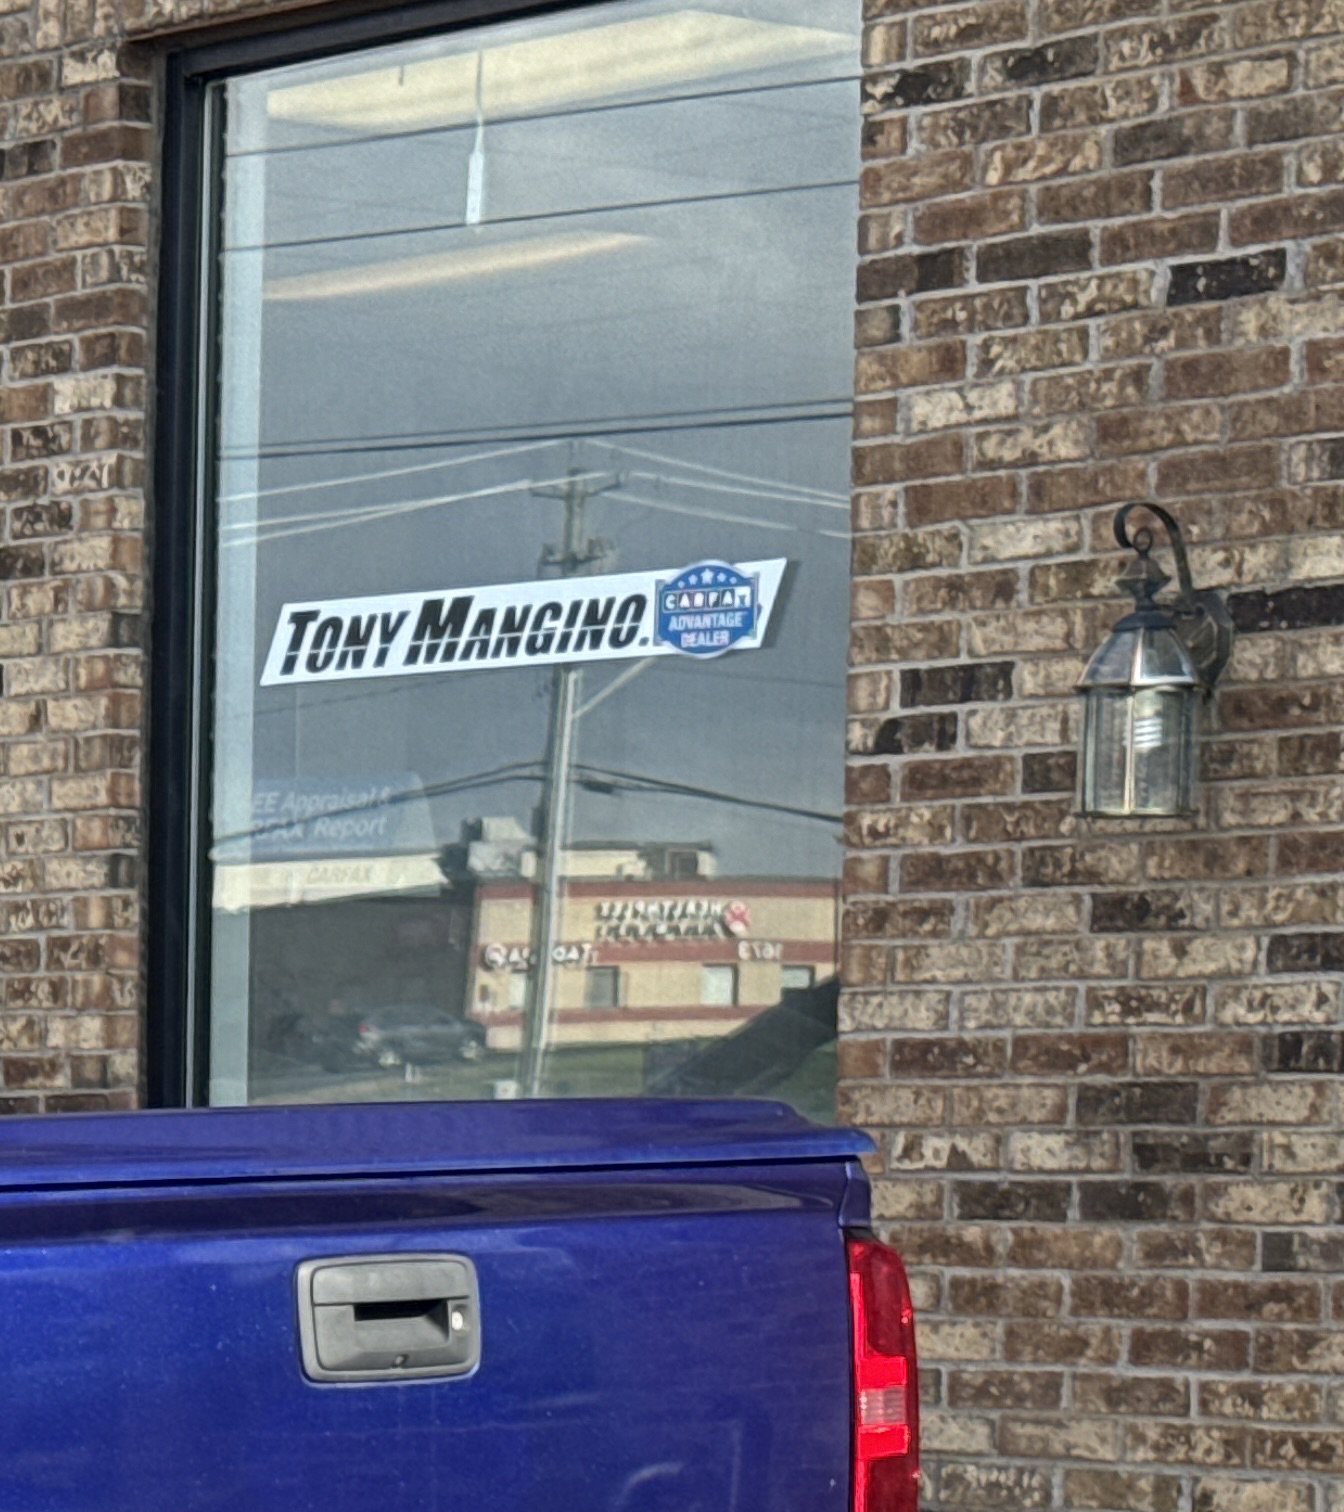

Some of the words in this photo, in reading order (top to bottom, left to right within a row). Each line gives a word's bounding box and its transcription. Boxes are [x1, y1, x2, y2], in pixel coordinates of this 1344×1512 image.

[664, 586, 752, 612] CARFAX
[667, 611, 748, 631] ADVANTAGE
[680, 630, 730, 648] DEALER
[314, 815, 387, 840] Report
